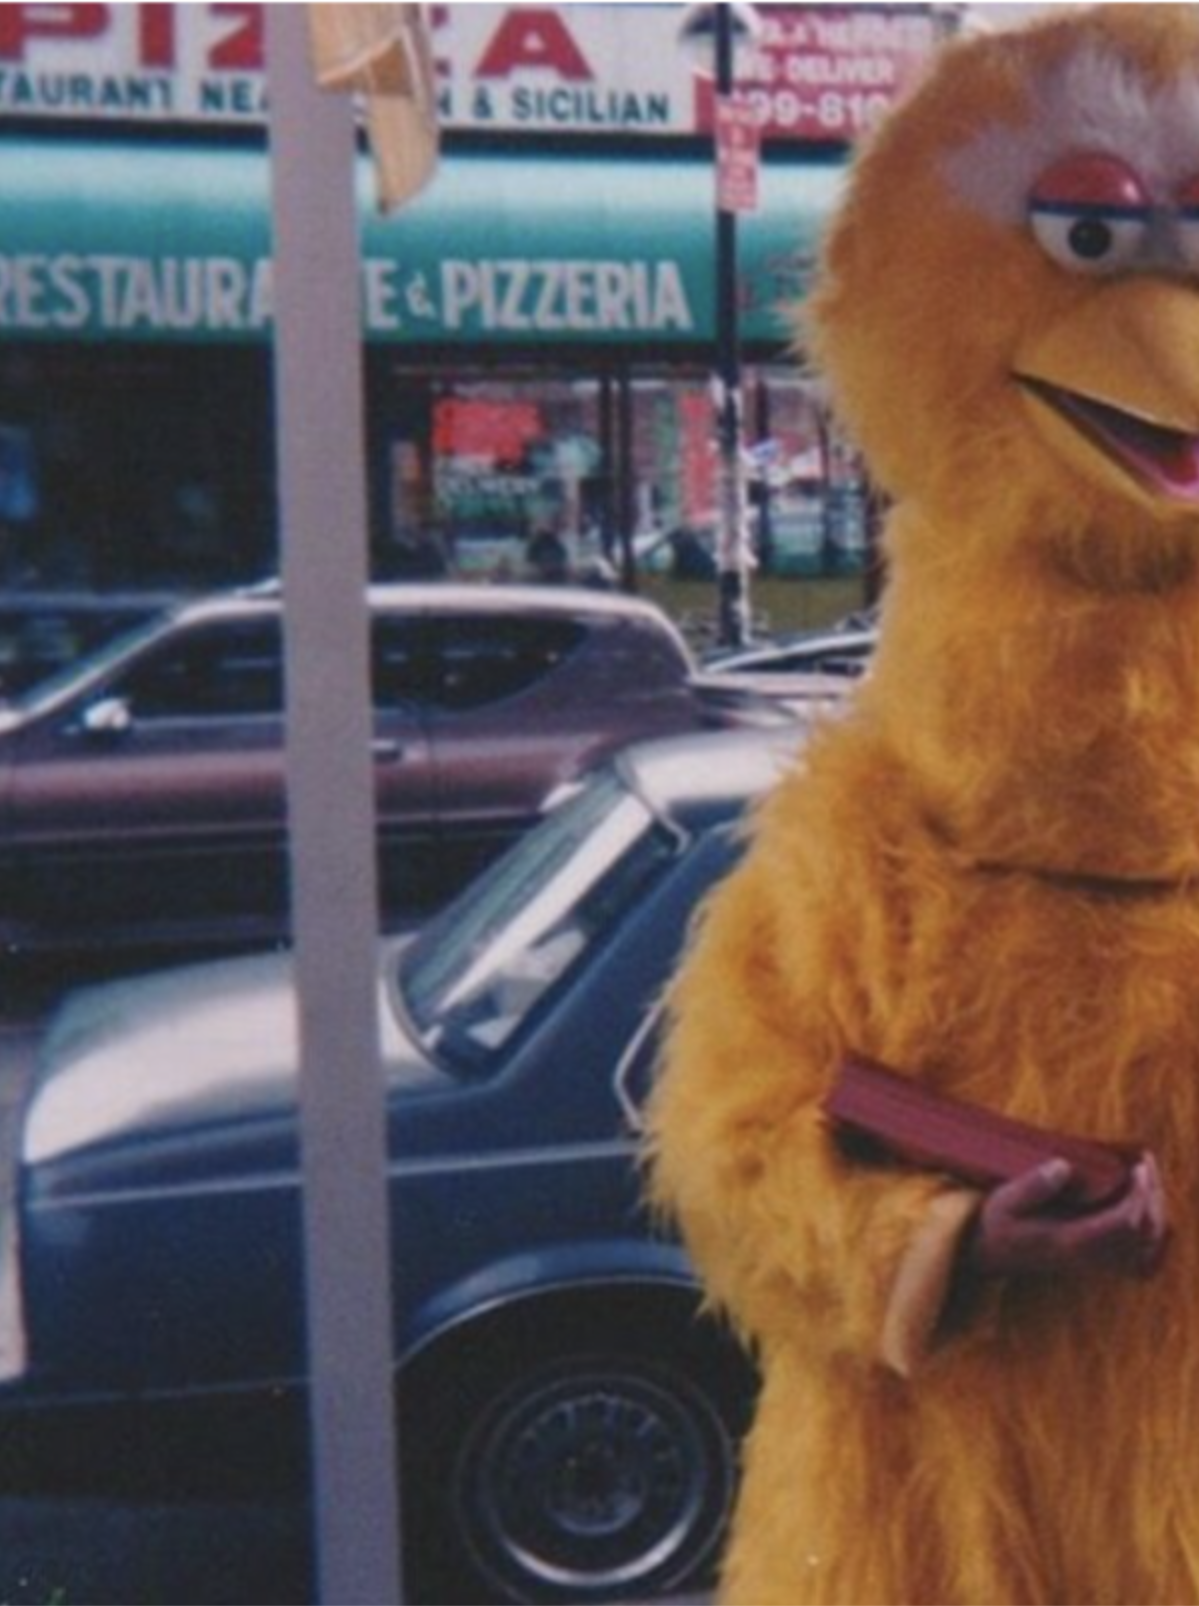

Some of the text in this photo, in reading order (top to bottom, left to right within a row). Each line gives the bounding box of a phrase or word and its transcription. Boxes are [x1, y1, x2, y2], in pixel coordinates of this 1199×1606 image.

[473, 86, 493, 118] &
[511, 87, 669, 122] SICILIAN
[440, 259, 693, 329] PIZZERIA
